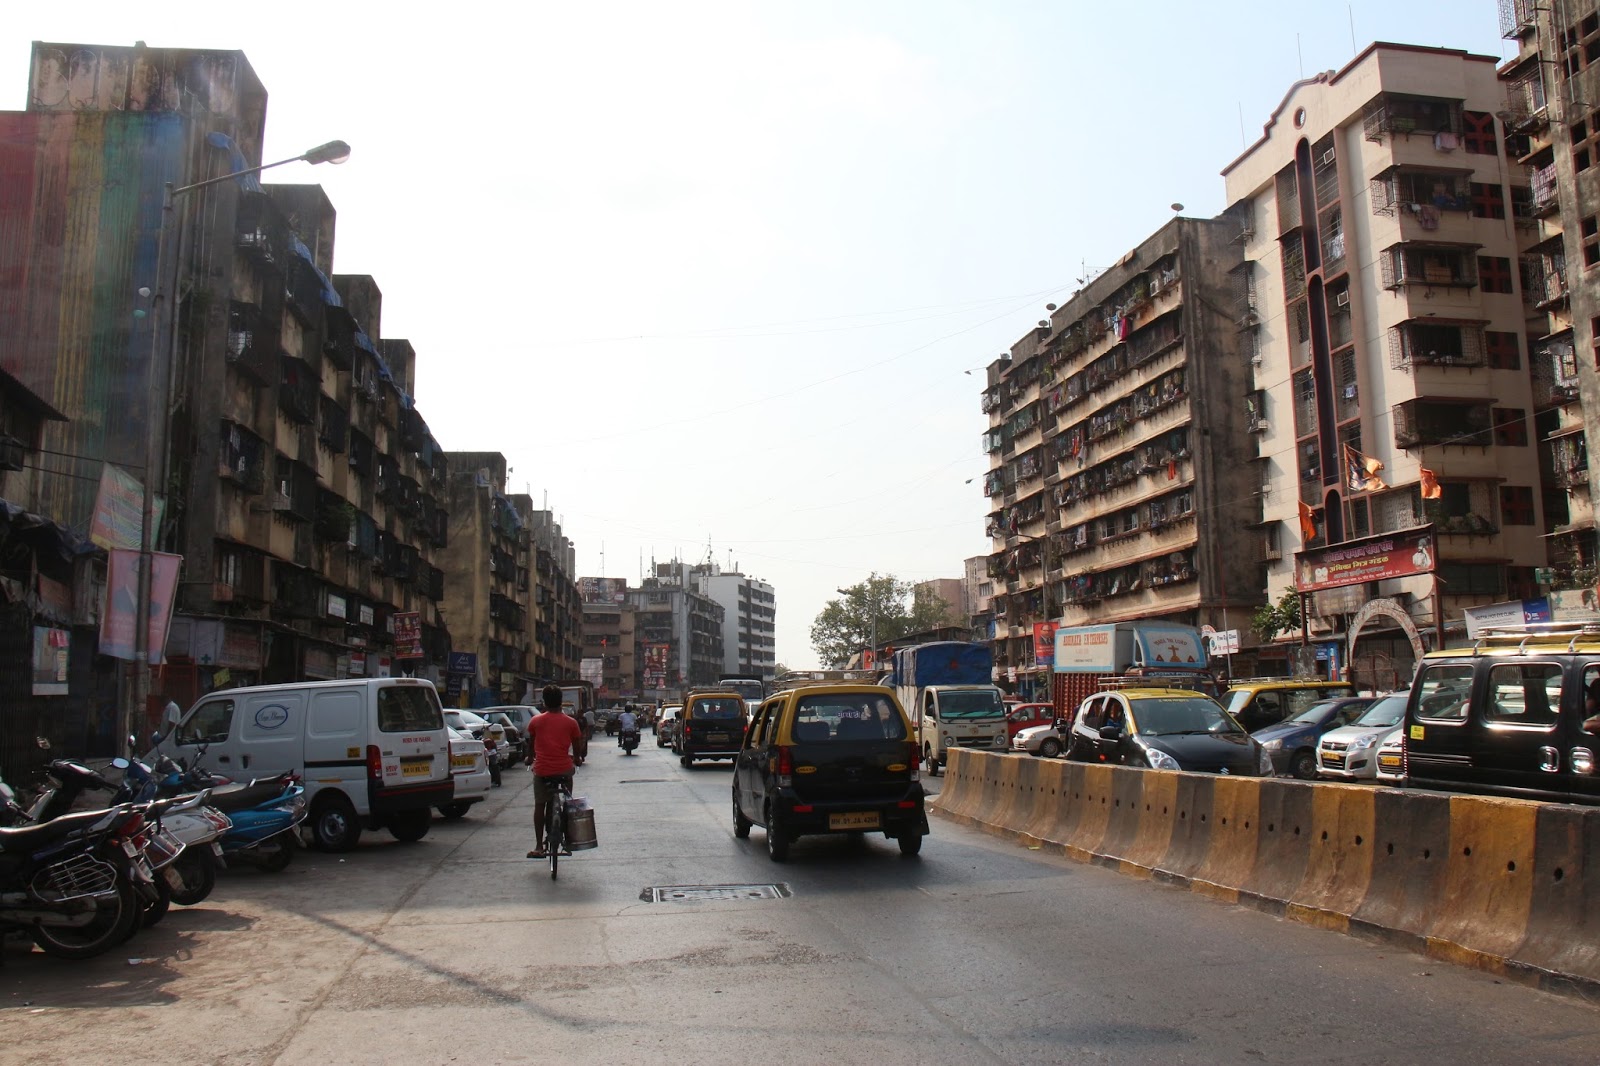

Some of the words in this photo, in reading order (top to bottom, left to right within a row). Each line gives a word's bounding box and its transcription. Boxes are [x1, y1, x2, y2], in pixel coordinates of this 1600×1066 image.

[1329, 562, 1351, 574] अंबिका
[1369, 555, 1389, 565] मंडळ
[1175, 638, 1187, 646] LORD
